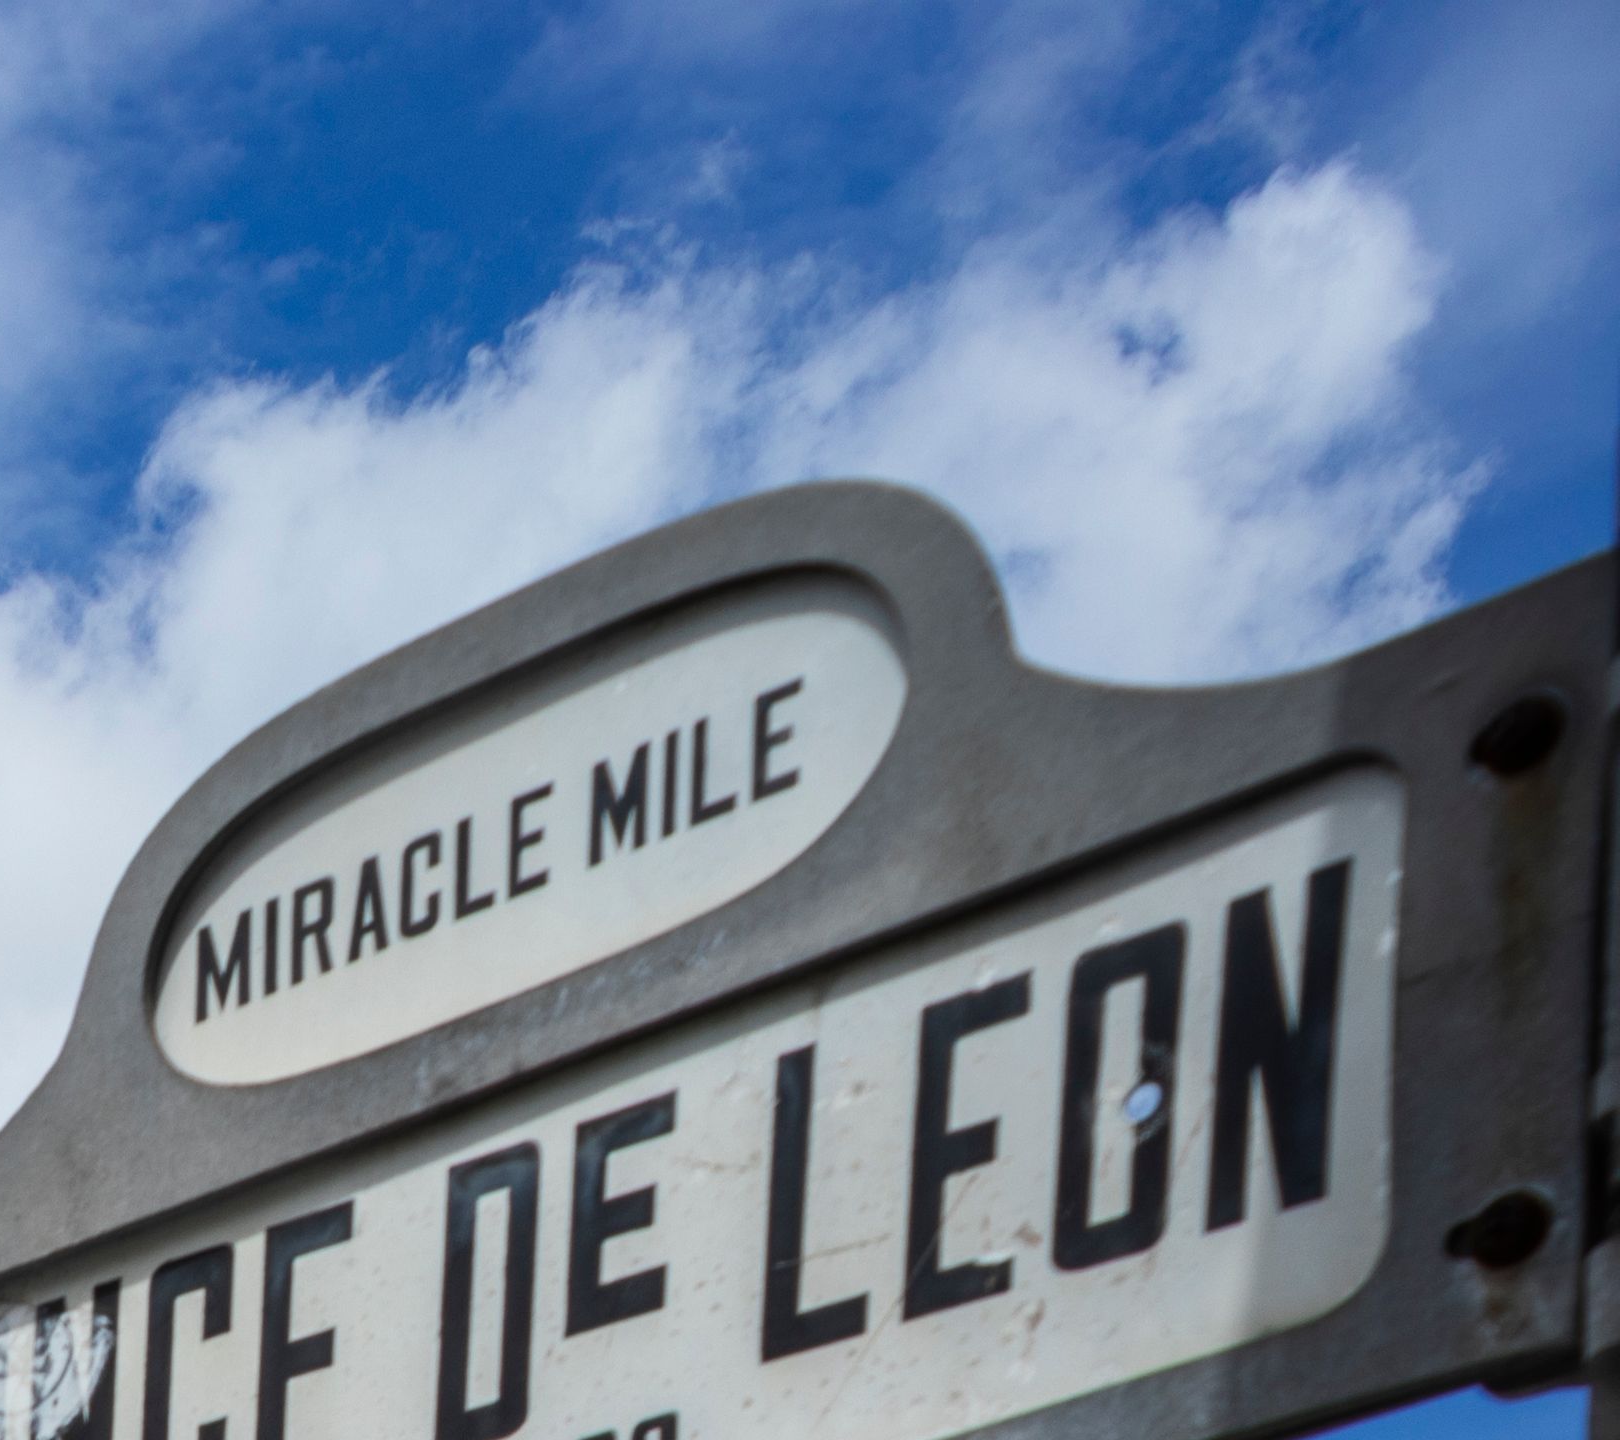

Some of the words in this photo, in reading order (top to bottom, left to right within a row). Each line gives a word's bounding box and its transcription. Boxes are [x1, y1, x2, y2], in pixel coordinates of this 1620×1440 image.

[192, 784, 556, 1026] MIRACLE
[587, 678, 805, 867] MILE
[761, 858, 1354, 1362] LEON
